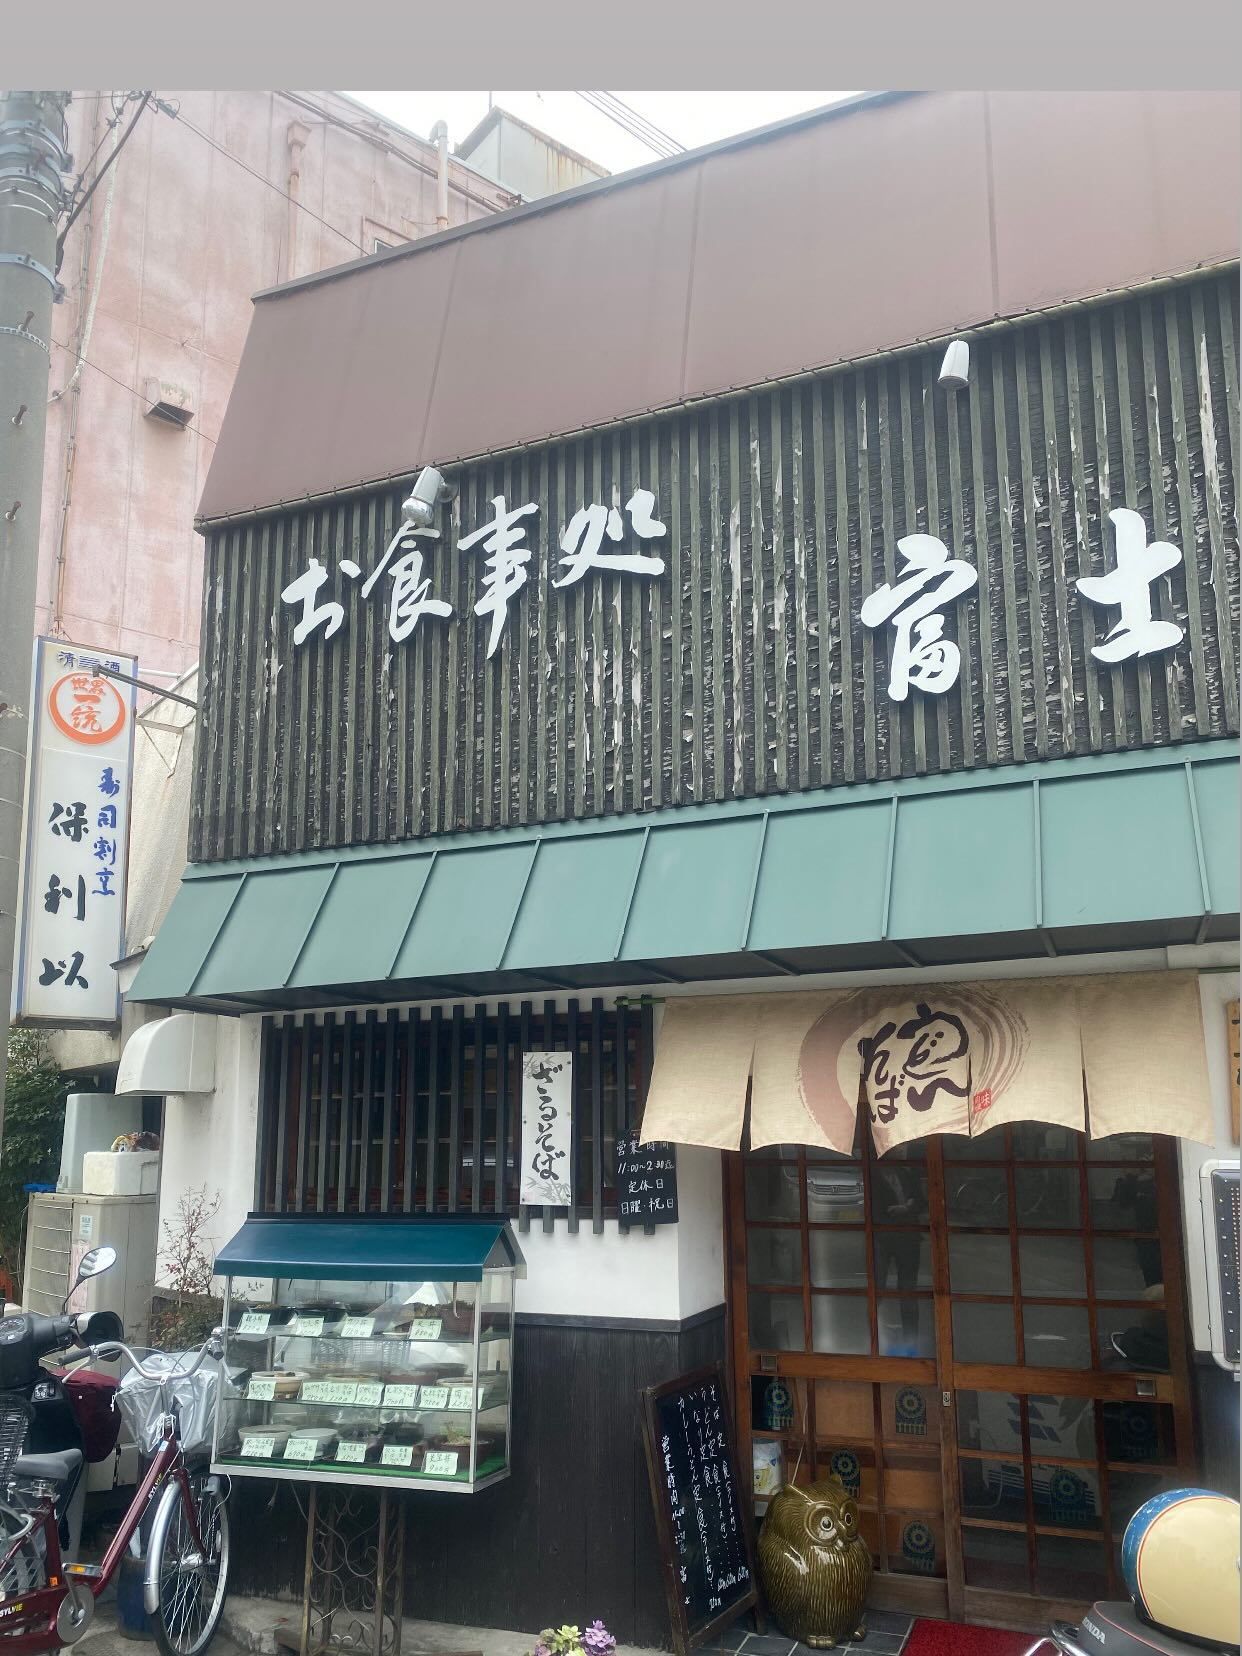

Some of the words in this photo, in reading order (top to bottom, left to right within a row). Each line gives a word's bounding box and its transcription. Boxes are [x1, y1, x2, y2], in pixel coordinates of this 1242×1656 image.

[281, 489, 667, 660] お食事処
[861, 508, 1184, 702] 富士
[531, 1061, 567, 1181] ざるそば
[628, 1178, 664, 1194] 定休日
